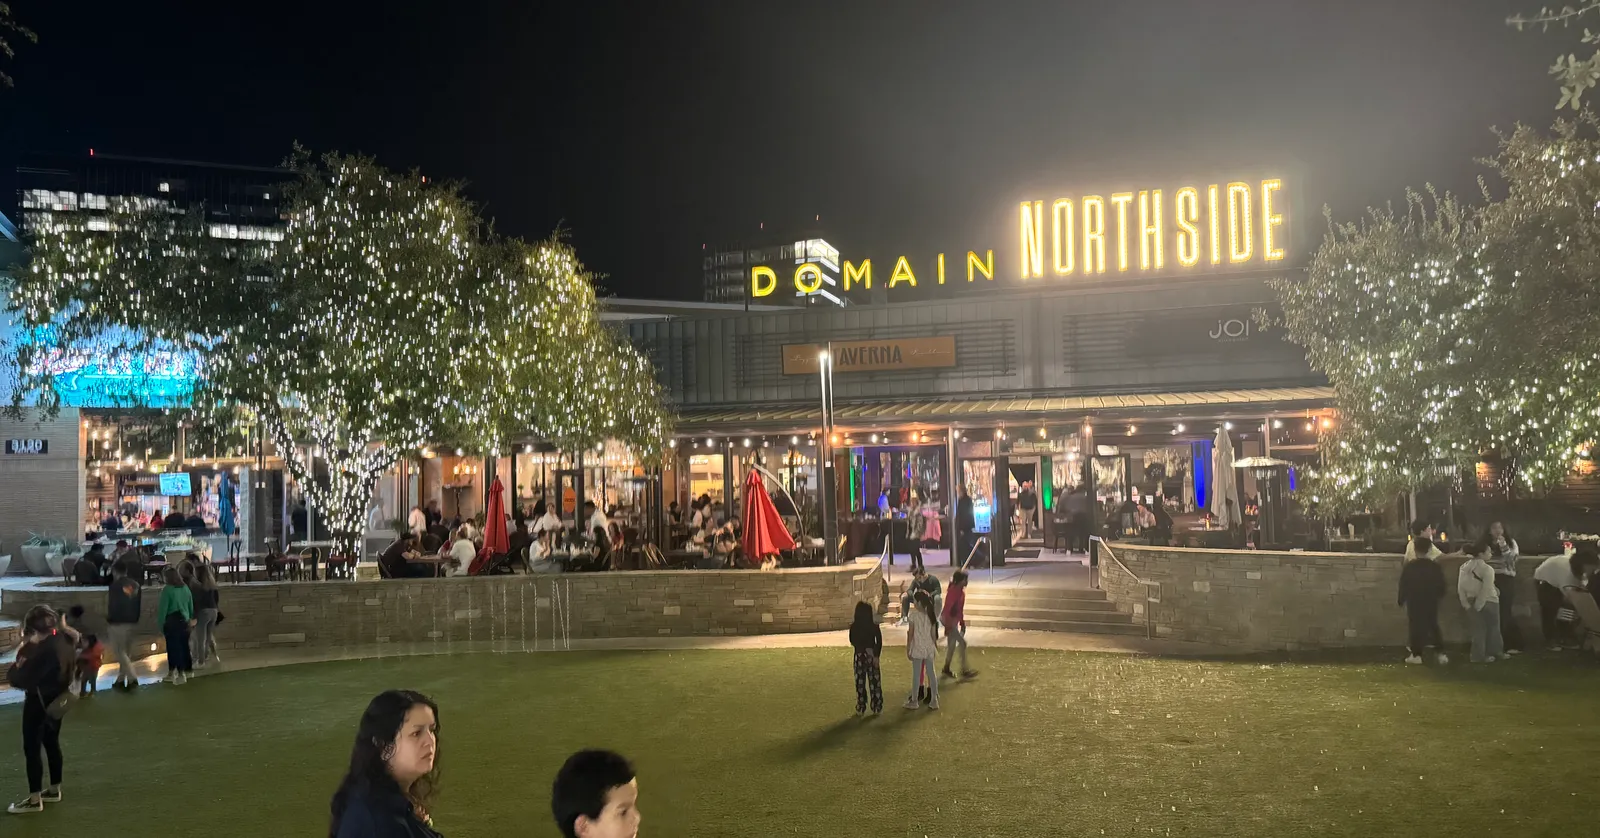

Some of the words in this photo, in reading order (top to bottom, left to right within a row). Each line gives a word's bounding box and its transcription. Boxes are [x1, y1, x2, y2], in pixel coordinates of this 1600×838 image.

[751, 249, 994, 298] DOMAIN
[1020, 178, 1285, 279] NORTHSIDE
[832, 345, 903, 366] TAVERNA
